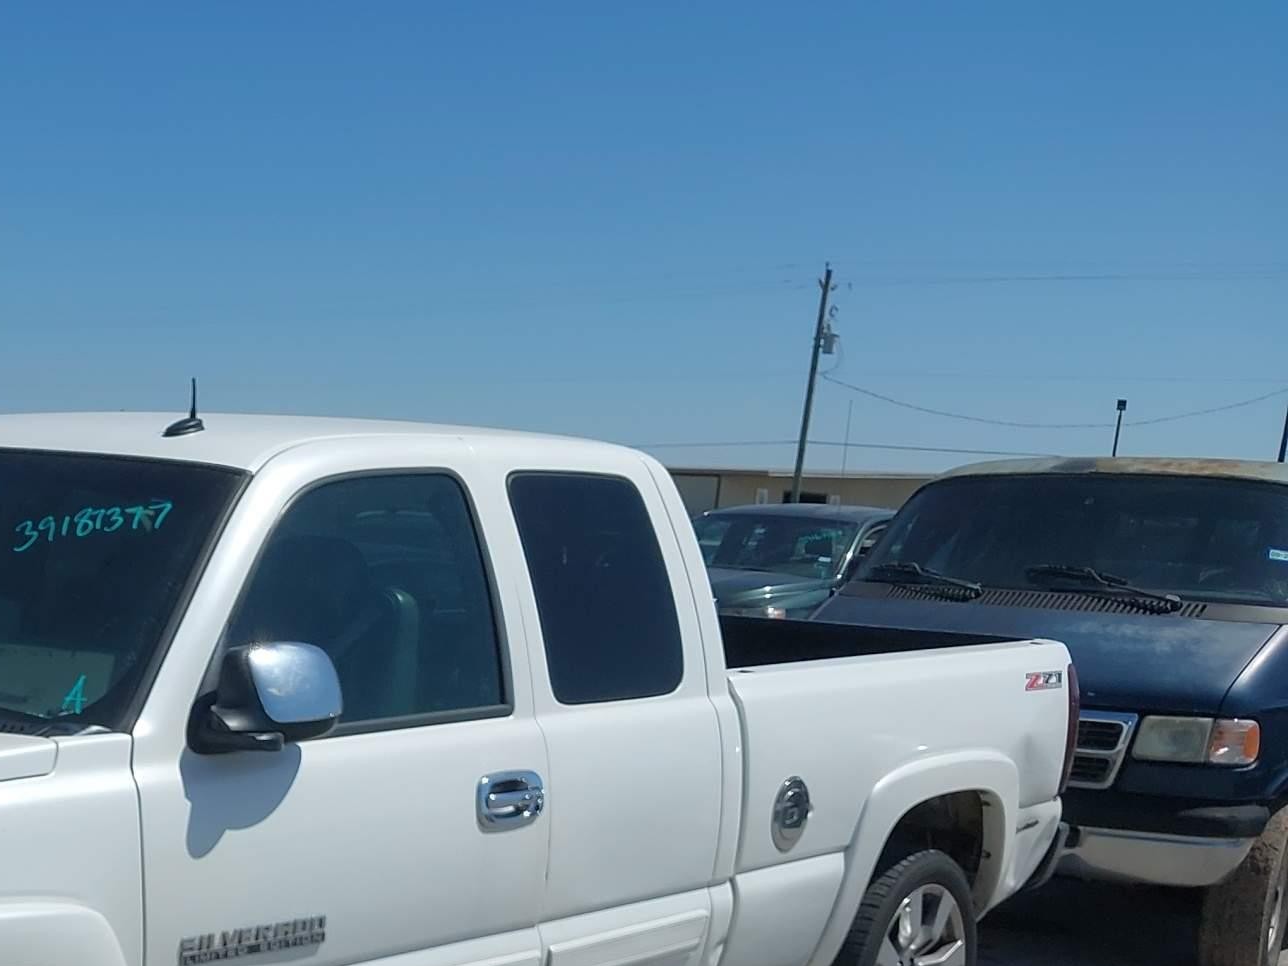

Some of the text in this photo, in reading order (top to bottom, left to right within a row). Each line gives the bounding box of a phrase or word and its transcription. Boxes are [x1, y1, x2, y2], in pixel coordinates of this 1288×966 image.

[1025, 671, 1063, 691] Z71
[180, 914, 327, 951] SILVERADO
[263, 930, 326, 951] EDITION
